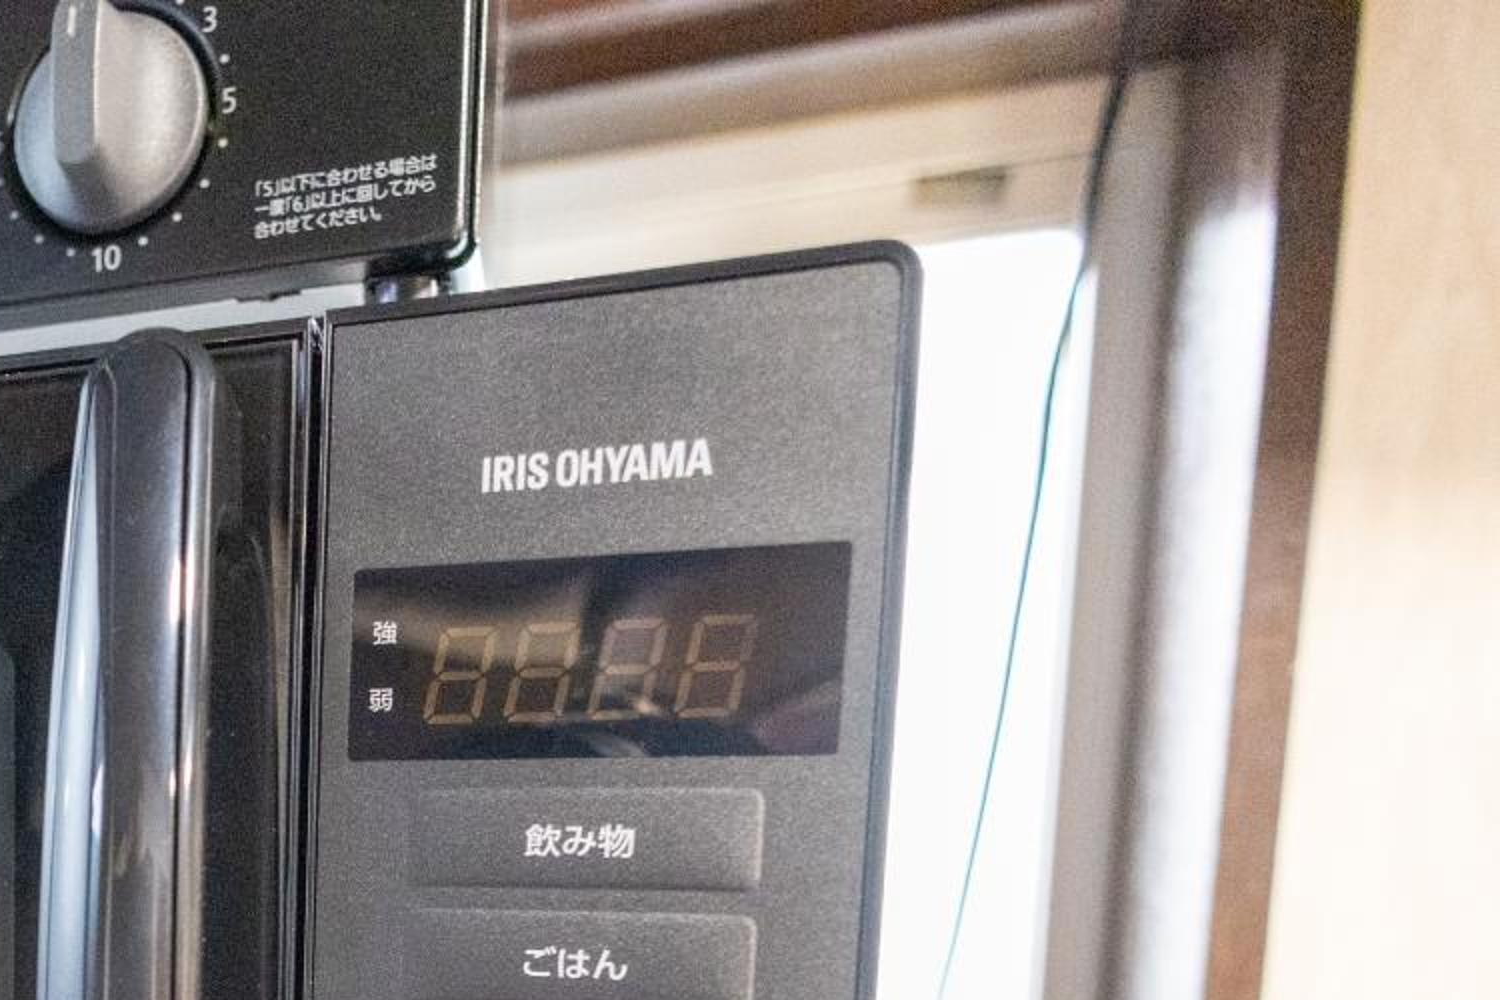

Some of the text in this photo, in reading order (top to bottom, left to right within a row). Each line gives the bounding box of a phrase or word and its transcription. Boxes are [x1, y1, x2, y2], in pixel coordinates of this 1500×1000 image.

[201, 6, 218, 33] 3
[221, 86, 237, 114] 5
[91, 245, 122, 272] 10
[481, 438, 714, 494] IRIS OHYAMA
[373, 621, 398, 646] 強
[368, 688, 394, 713] 弱
[524, 822, 637, 859] 飲み物
[522, 945, 629, 981] ごはん
